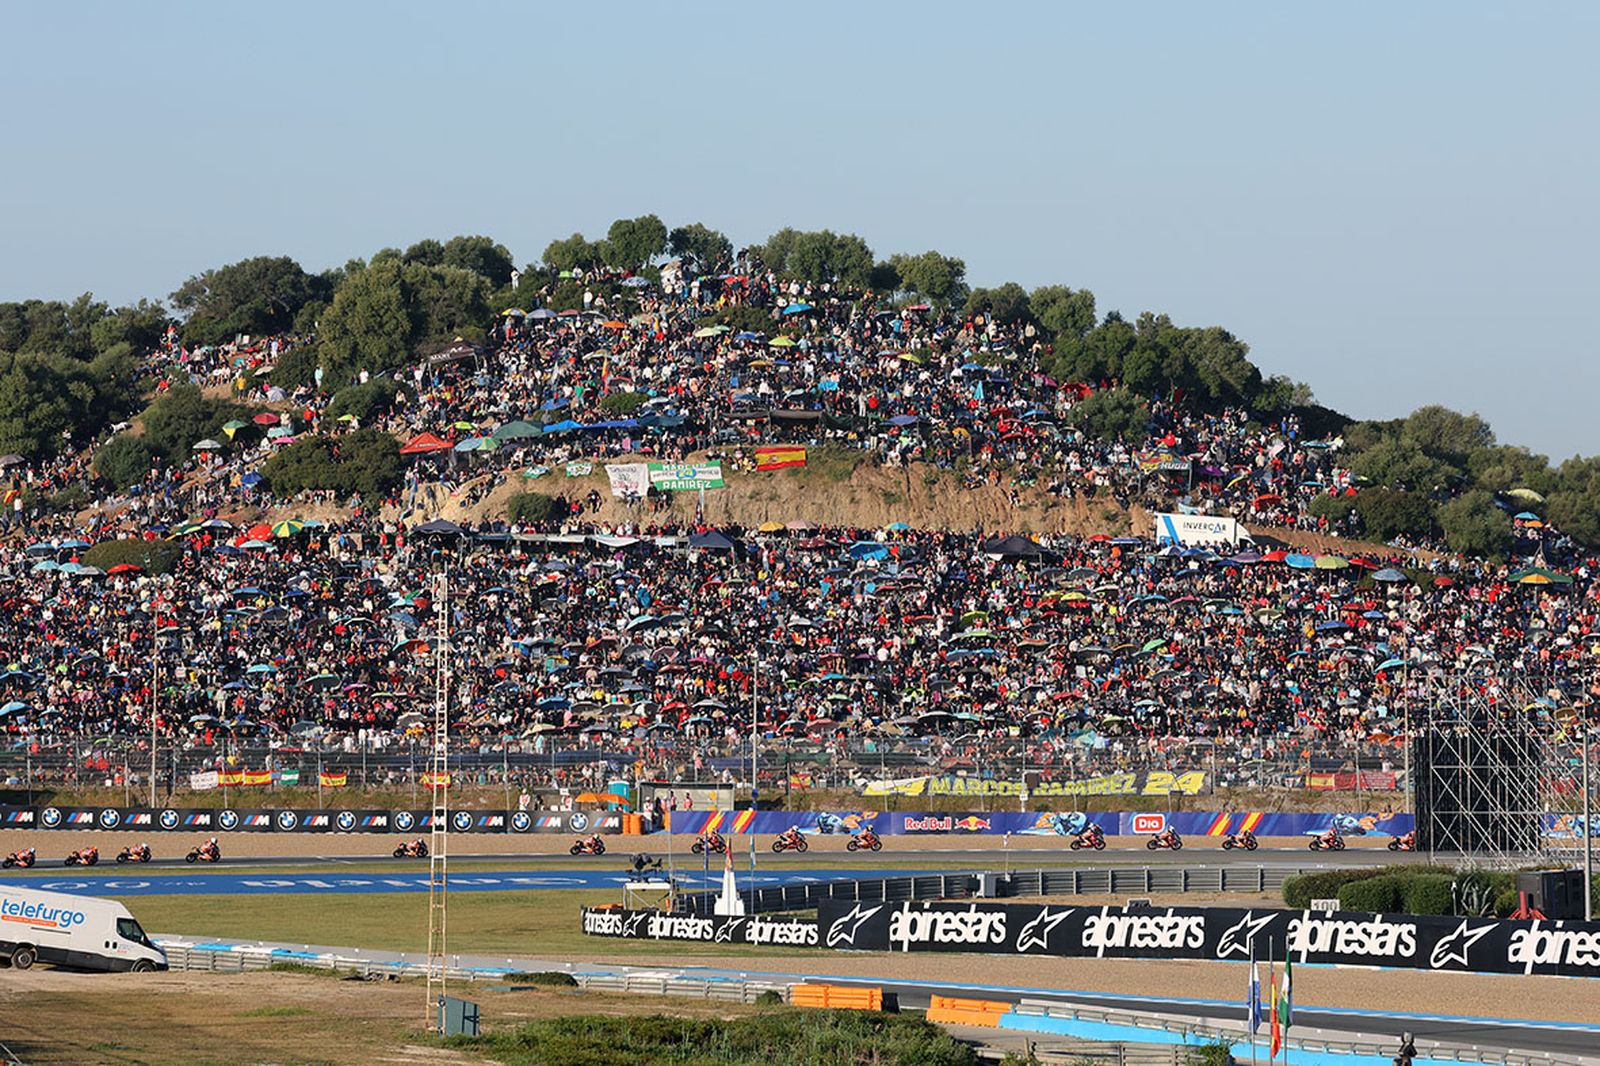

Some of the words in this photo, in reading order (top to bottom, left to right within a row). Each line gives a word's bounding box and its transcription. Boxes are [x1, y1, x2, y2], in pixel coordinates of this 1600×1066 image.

[663, 480, 712, 490] RAMIREZ
[928, 776, 1029, 796] MARCOS
[1141, 771, 1206, 796] 24
[905, 817, 928, 830] Red
[929, 816, 952, 830] Bull
[1138, 818, 1159, 829] Dia
[1, 899, 85, 928] telefurgo
[647, 911, 714, 939] alpinestars
[889, 901, 1007, 952] alpinestars
[745, 916, 819, 945] alpinestars
[1082, 906, 1205, 958] alpinestars
[1287, 909, 1417, 964] alpinestars
